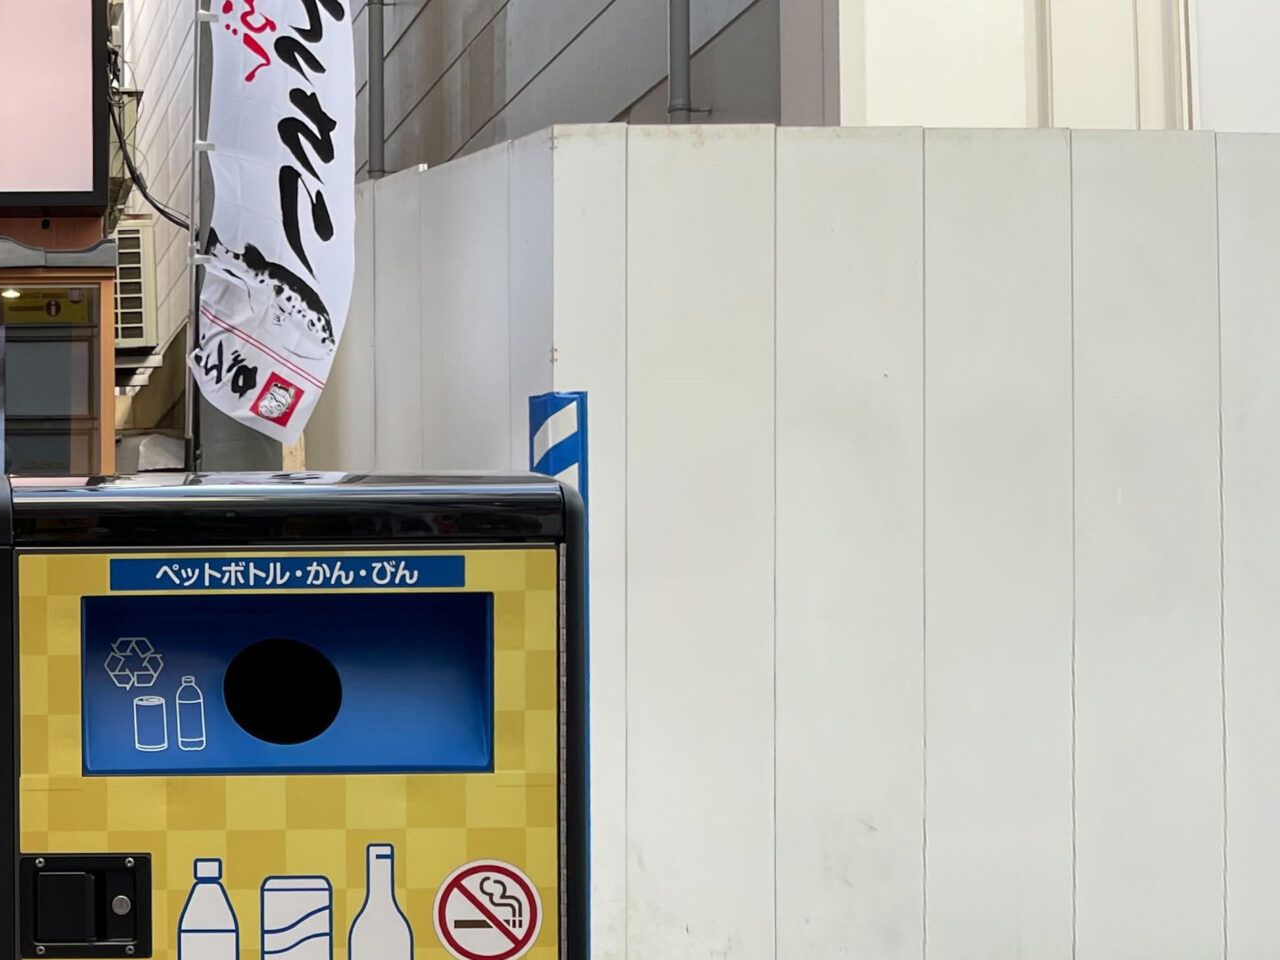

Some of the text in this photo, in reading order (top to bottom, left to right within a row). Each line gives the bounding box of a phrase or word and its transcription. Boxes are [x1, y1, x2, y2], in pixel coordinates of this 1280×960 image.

[155, 560, 419, 587] ペットボトル・かん・びん
